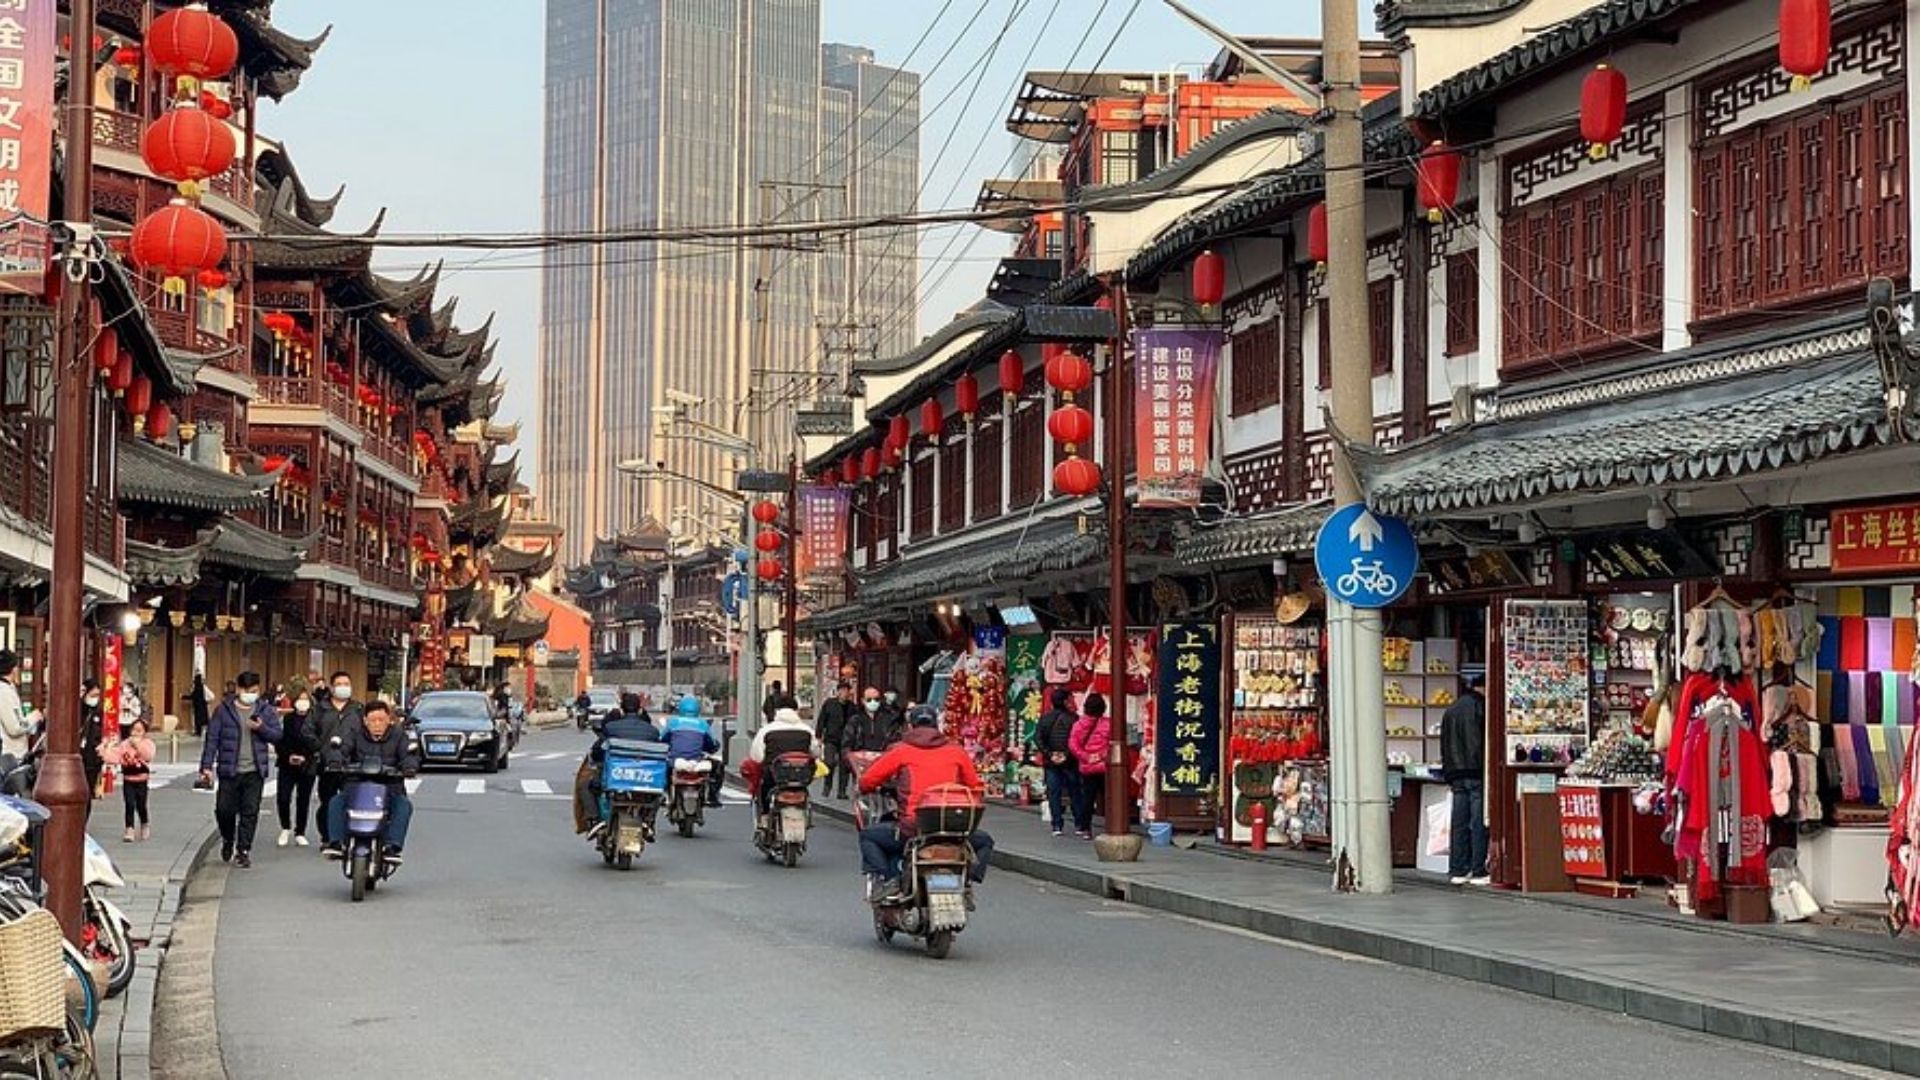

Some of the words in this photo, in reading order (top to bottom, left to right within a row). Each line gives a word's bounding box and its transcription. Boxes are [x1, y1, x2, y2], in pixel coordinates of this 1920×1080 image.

[1152, 347, 1171, 473] 建设美丽新家园
[1176, 347, 1195, 472] 垃圾分类新时尚
